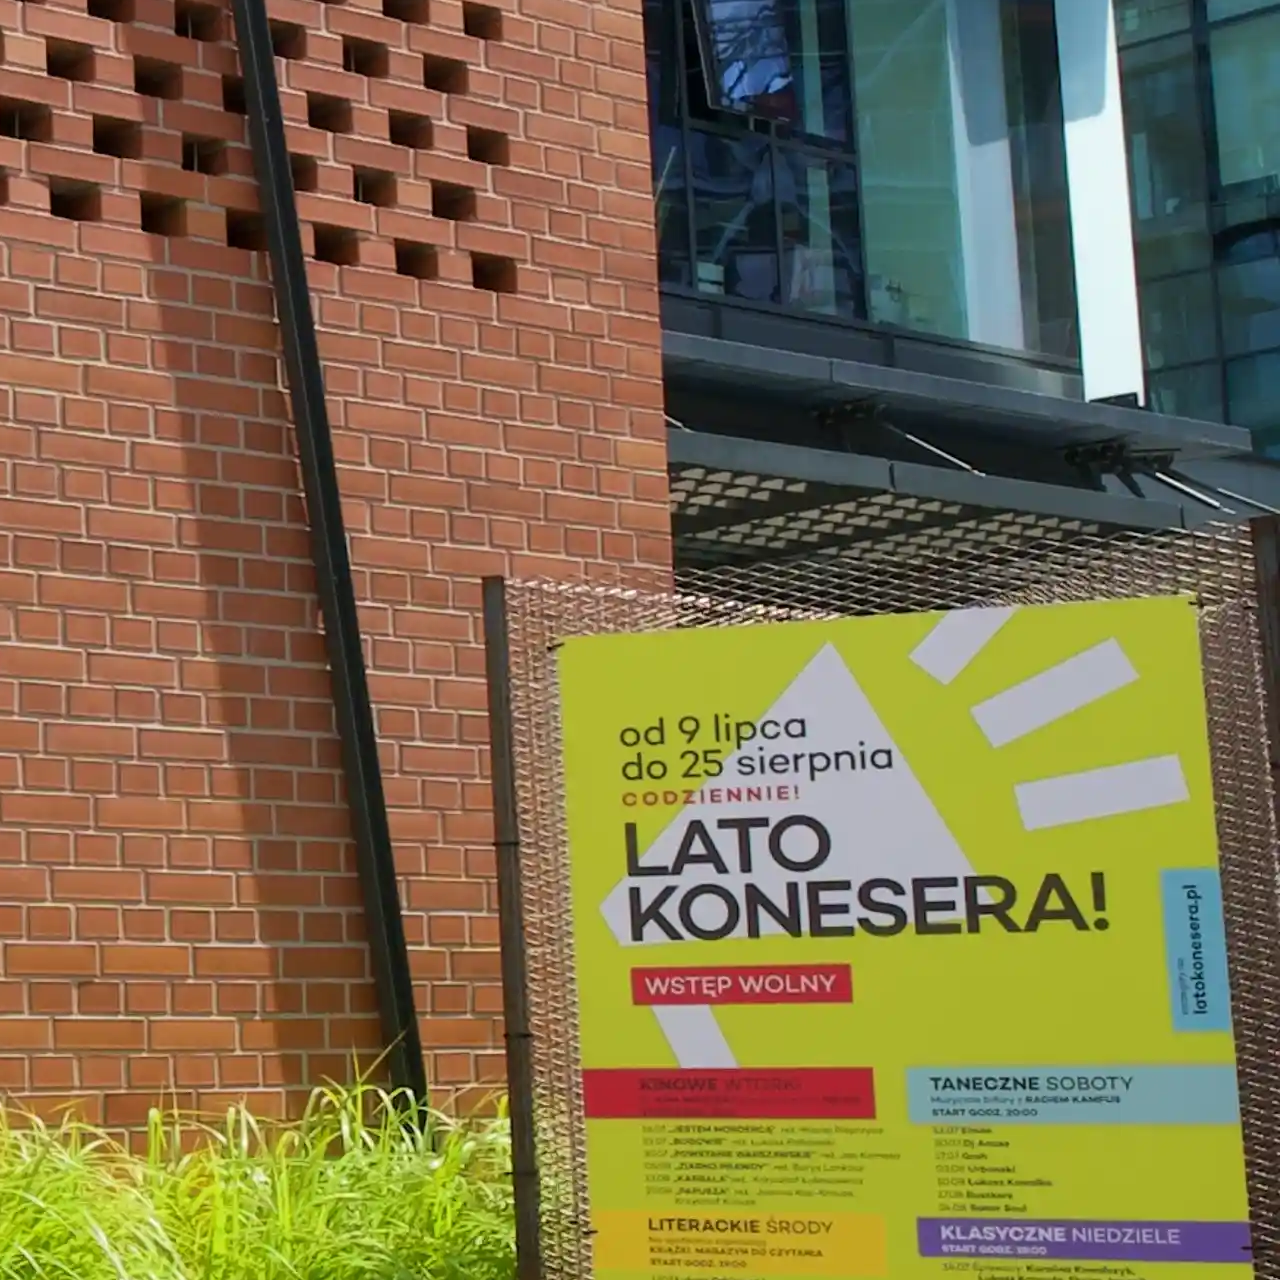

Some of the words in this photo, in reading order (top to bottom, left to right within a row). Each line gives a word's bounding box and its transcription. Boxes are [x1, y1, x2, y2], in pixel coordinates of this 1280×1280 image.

[619, 715, 668, 748] od
[676, 716, 701, 744] 9
[712, 712, 807, 752] lipca
[621, 752, 669, 781] do
[679, 751, 724, 778] 25
[735, 742, 894, 783] sierpnia
[621, 784, 802, 807] CODZIENNIE!
[624, 814, 832, 877] LATO
[628, 871, 1111, 942] KONESERA!
[1181, 884, 1208, 1015] latokonesera.pl
[643, 974, 733, 999] WSTĘP
[738, 973, 837, 996] WOLNY
[929, 1076, 1040, 1091] TANECZNE
[1045, 1076, 1134, 1091] SOBOTY
[931, 1108, 967, 1117] START
[648, 1217, 761, 1234] LITERACKIE
[766, 1216, 834, 1235] ŚRODY
[940, 1225, 1068, 1243] KLASYCZNE
[1071, 1228, 1181, 1245] NIEDZIELE
